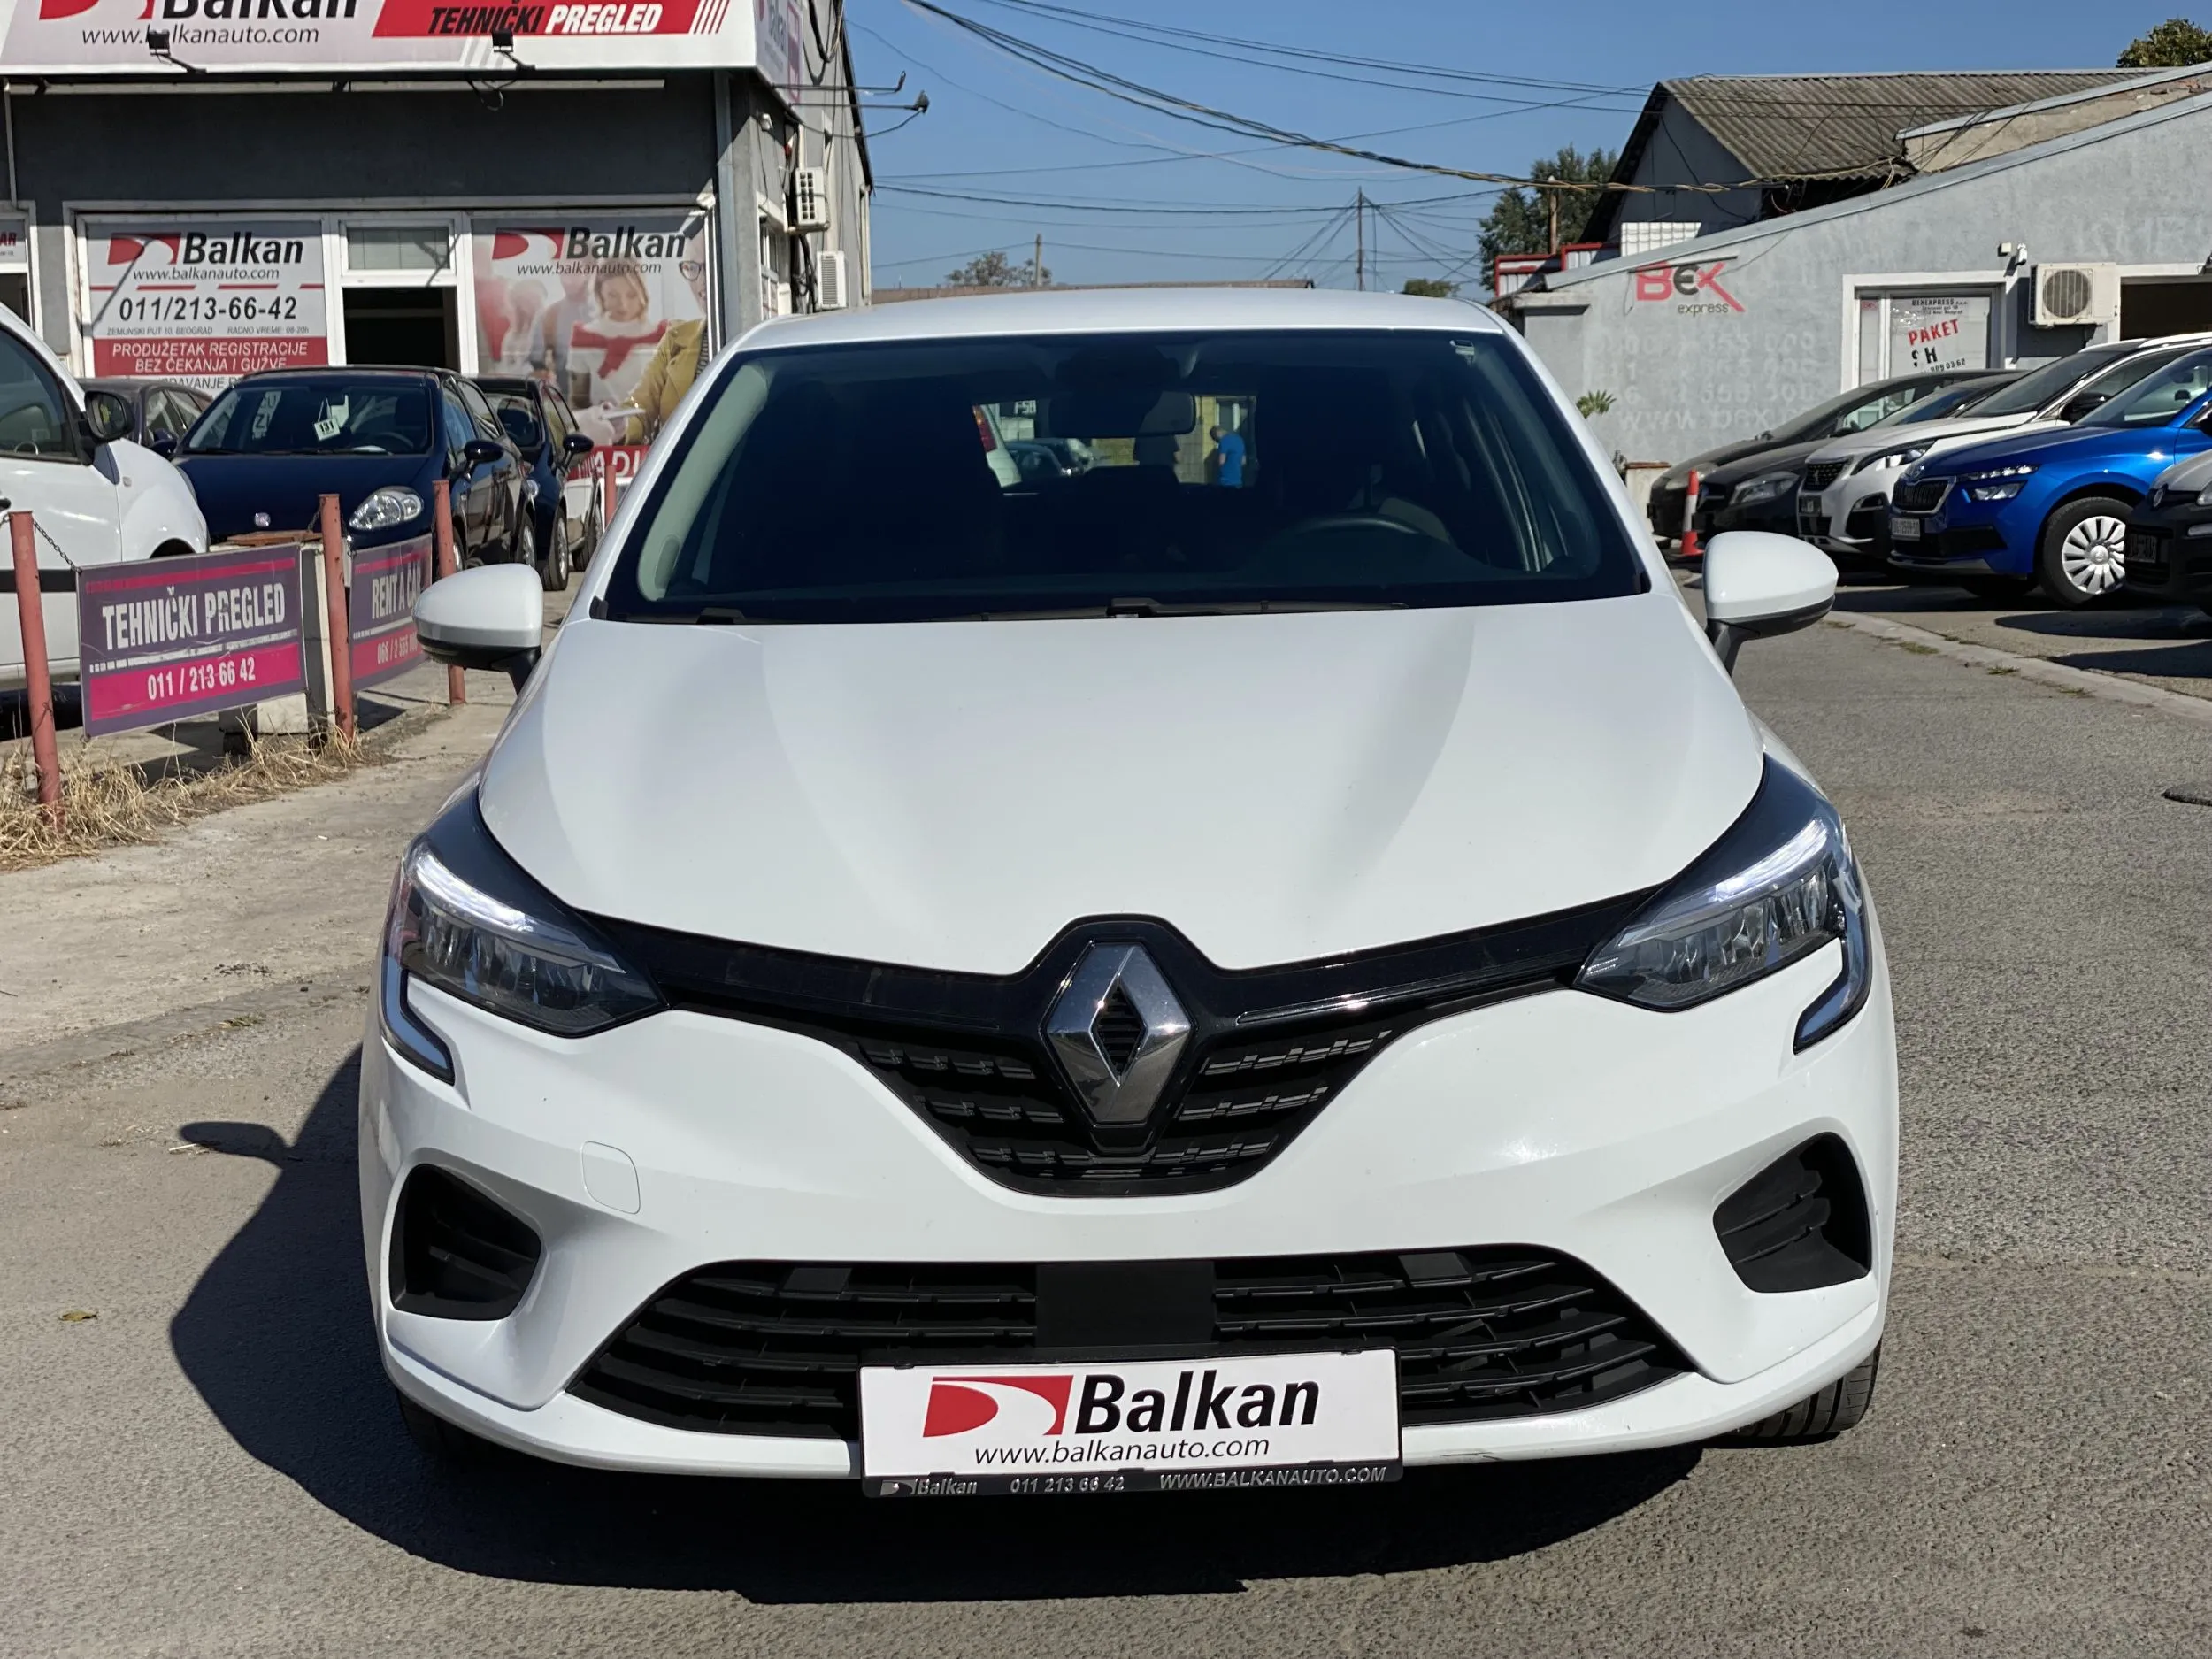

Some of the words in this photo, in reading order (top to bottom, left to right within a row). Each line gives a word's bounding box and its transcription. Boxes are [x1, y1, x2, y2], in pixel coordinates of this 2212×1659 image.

[544, 4, 663, 34] PREGLED
[182, 232, 303, 265] Balkan
[566, 227, 686, 258] Balkan
[133, 267, 280, 280] www.balkanauto.com
[518, 262, 662, 276] www.balkanauto.com
[119, 296, 296, 321] 011/213-66-42
[1678, 303, 1729, 317] express
[176, 326, 214, 335] BEOGRAD
[1908, 319, 1959, 346] PAKET
[112, 341, 205, 357] PRODUŽETAK
[209, 341, 308, 356] REGISTRACIJE
[135, 358, 162, 373] BEZ
[165, 356, 227, 372] ČEKANJA
[232, 357, 236, 370] I
[372, 573, 398, 619] RENT
[399, 571, 405, 611] A
[102, 586, 198, 650] TEHNIČKI
[204, 582, 285, 634] PREGLED
[148, 671, 173, 700] 011
[180, 668, 185, 695] /
[189, 664, 215, 692] 213
[219, 661, 236, 687] 66
[240, 657, 256, 681] 42
[1074, 1370, 1321, 1435] Balkan
[975, 1436, 1269, 1464] www.balkanauto.com
[915, 1477, 978, 1495] Balkan
[1010, 1477, 1039, 1493] 011
[1044, 1477, 1074, 1493] 213
[1079, 1476, 1099, 1492] 66
[1104, 1475, 1125, 1491] 42
[1159, 1467, 1386, 1490] WWW.BALKANAUTO.COM
